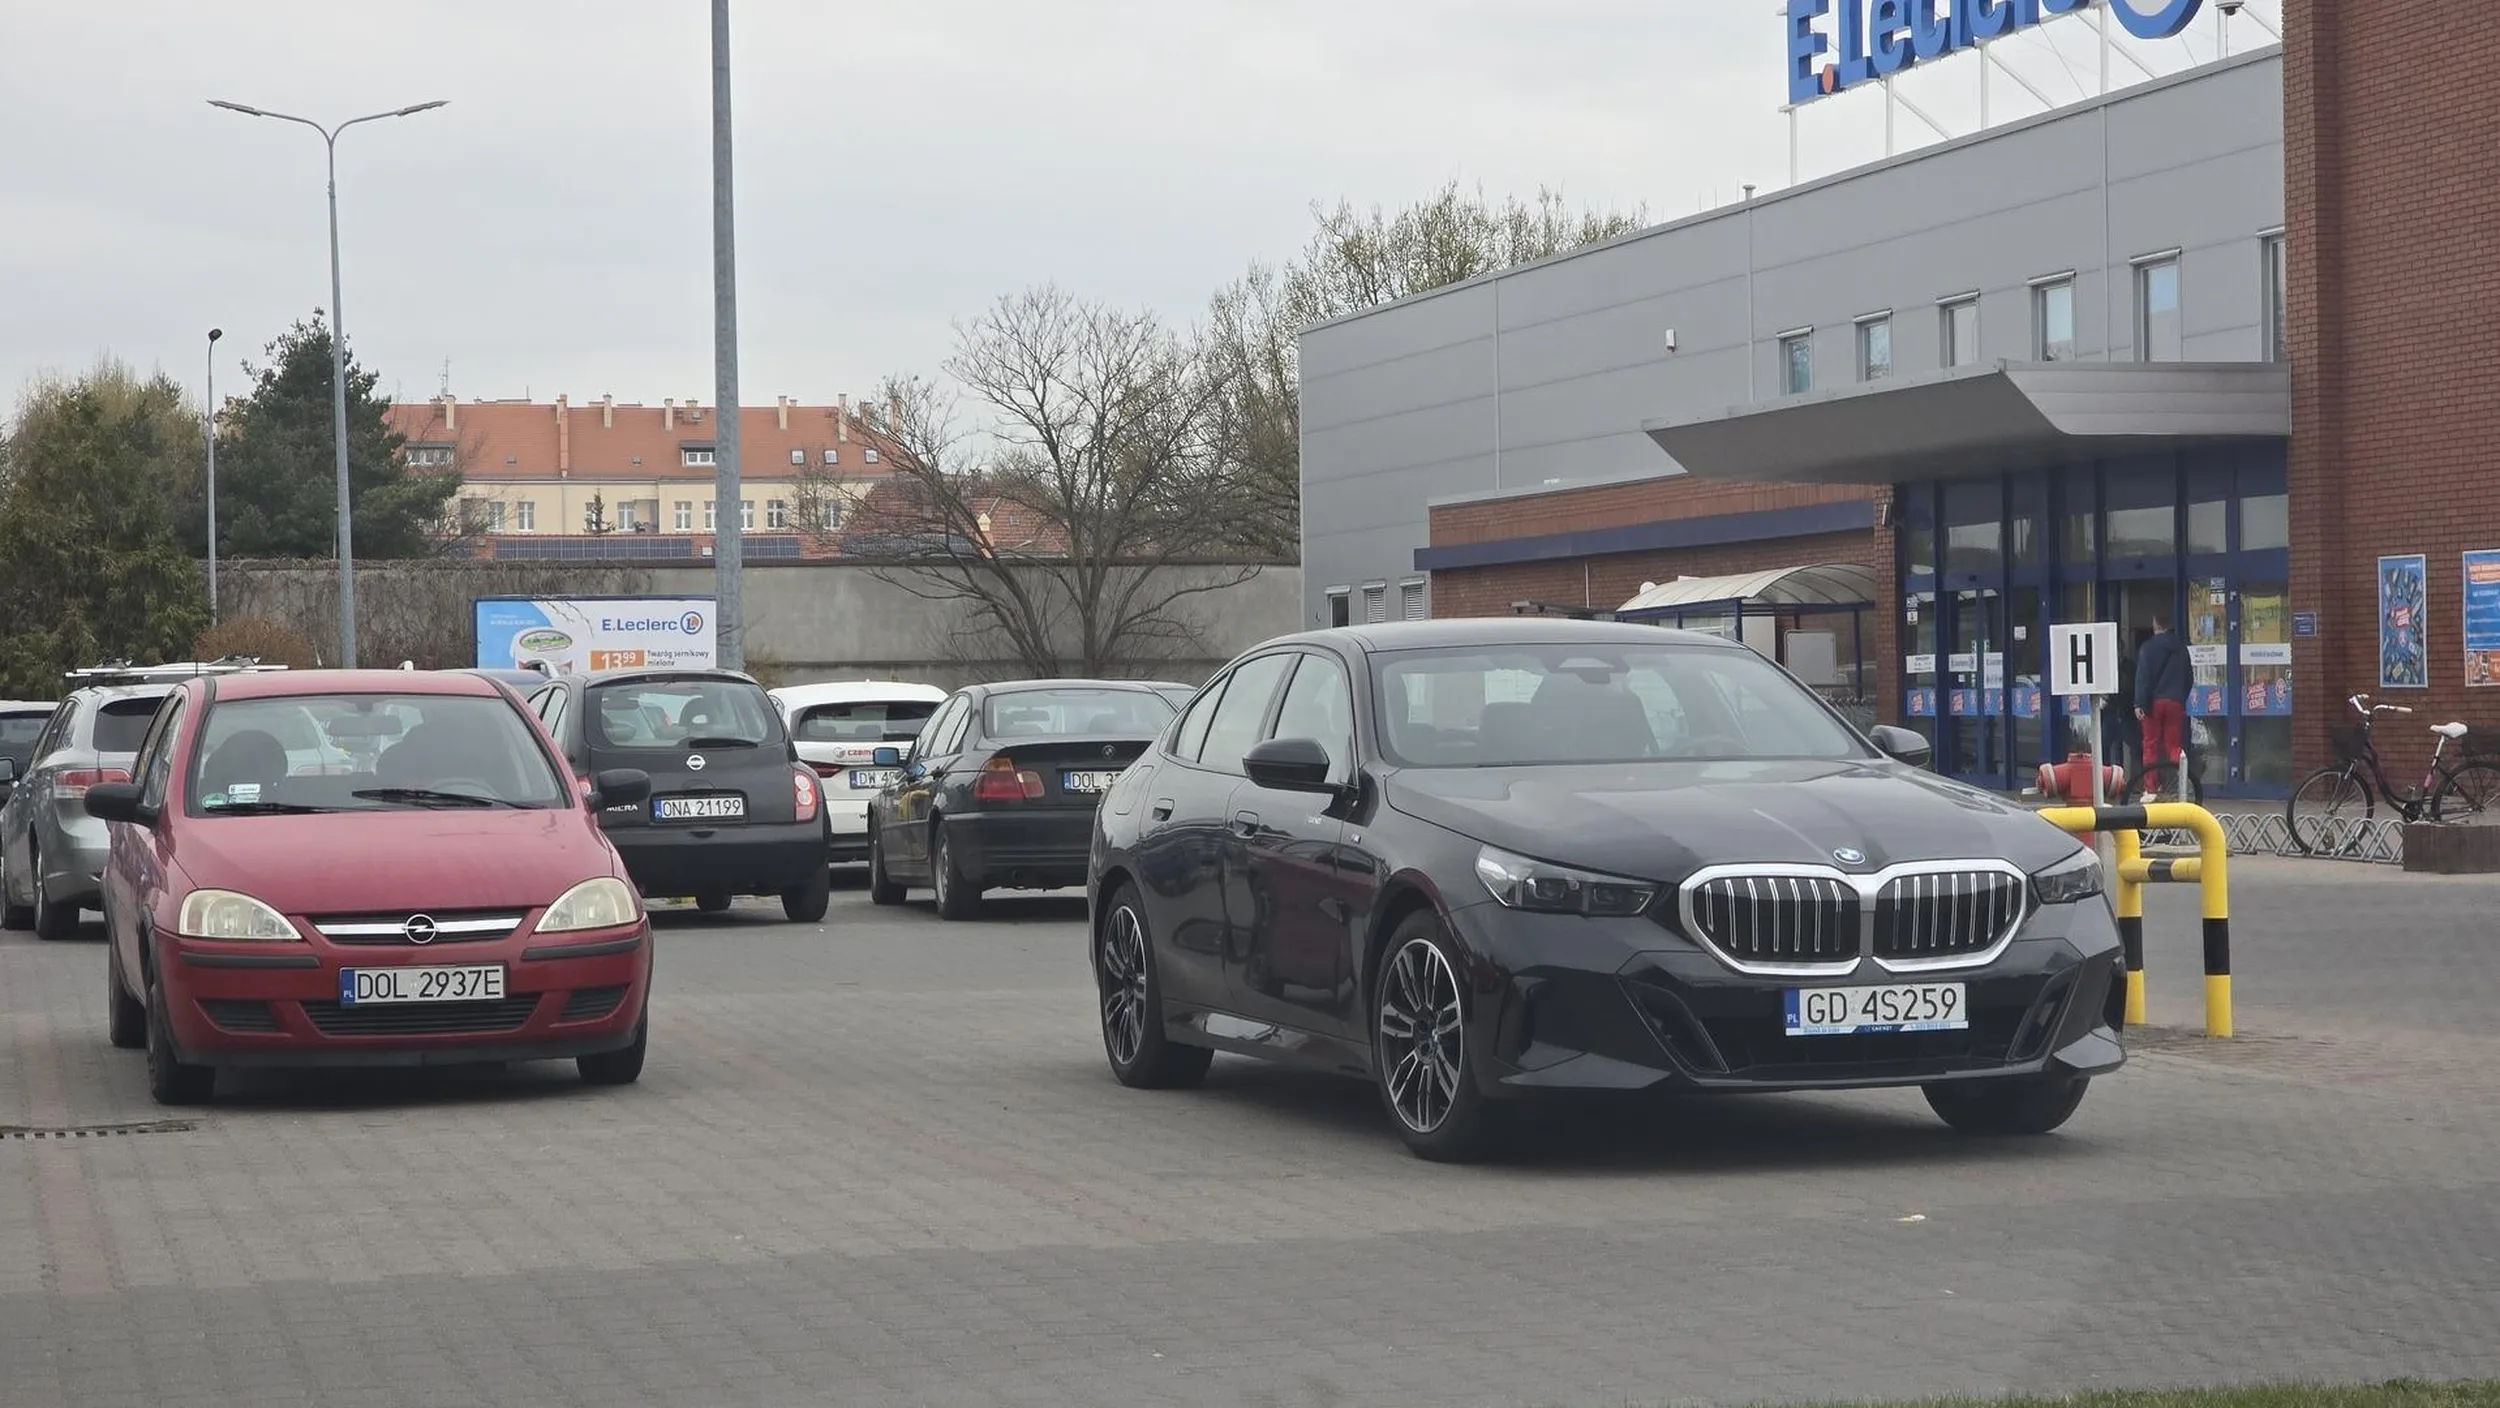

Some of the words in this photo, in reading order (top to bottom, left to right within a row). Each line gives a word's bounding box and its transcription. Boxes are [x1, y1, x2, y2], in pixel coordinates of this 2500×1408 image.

[1787, 0, 2090, 104] E.Lec
[602, 618, 677, 632] E.Leclerc
[2070, 633, 2093, 684] H
[859, 772, 876, 785] DW
[1072, 773, 1100, 788] DOL
[1105, 773, 1121, 786] 3
[606, 804, 638, 812] MICRA
[662, 801, 692, 817] ONA
[696, 800, 741, 816] 21199
[357, 972, 408, 999] DOL
[419, 969, 500, 998] 2937E
[1807, 992, 1847, 1024] GD
[1861, 987, 1957, 1022] 4S259
[1787, 1013, 1798, 1023] PL
